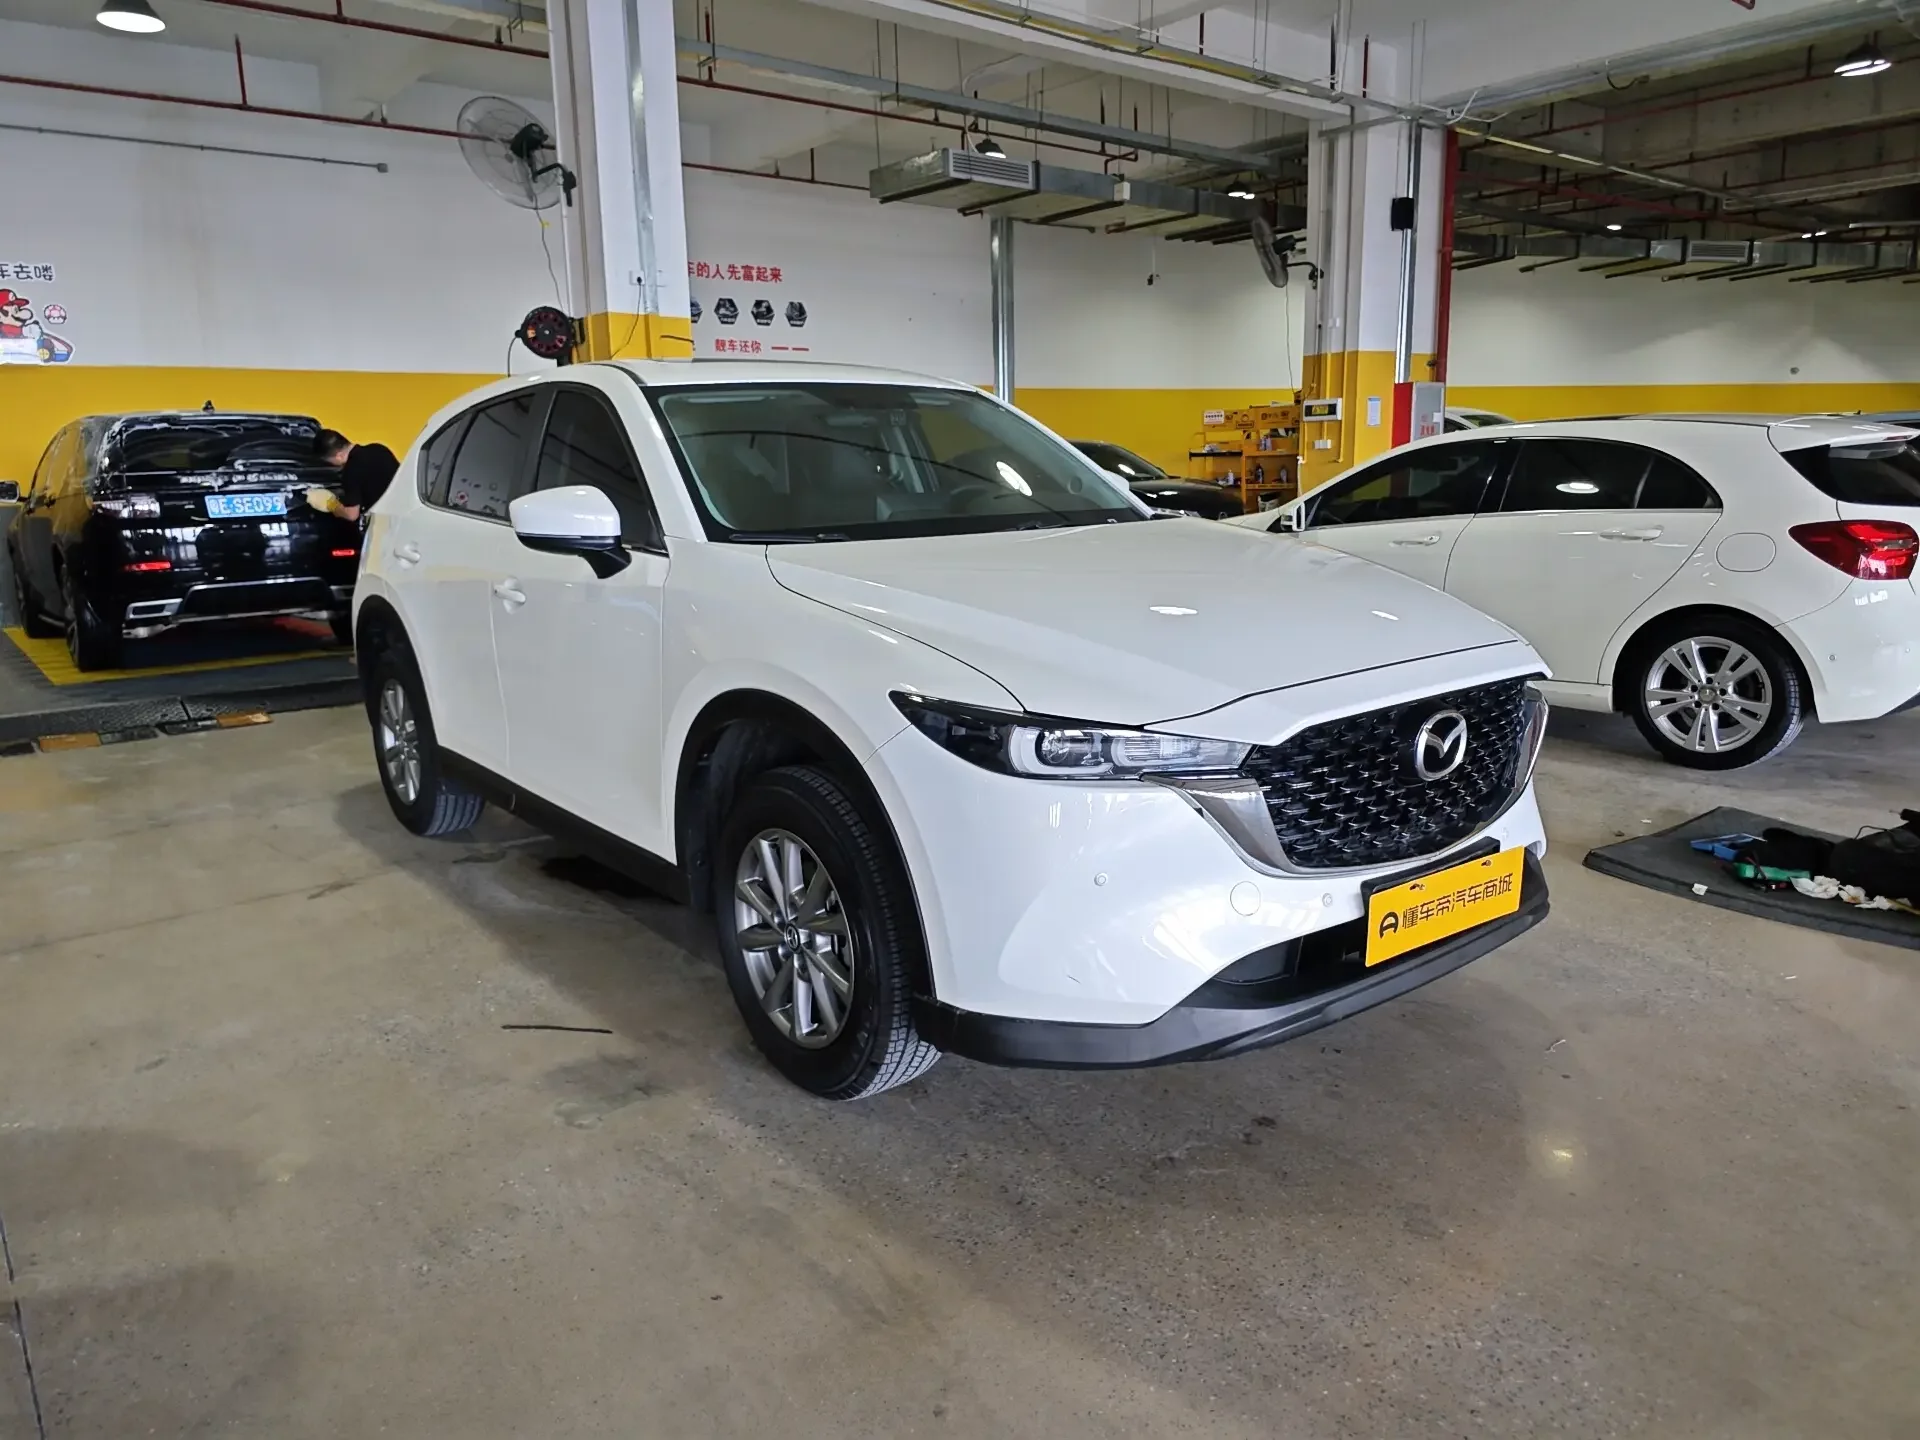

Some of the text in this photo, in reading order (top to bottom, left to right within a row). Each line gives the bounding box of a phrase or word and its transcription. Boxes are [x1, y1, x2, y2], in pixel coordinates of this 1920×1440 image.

[1402, 872, 1514, 929] 懂车帝汽车商城
